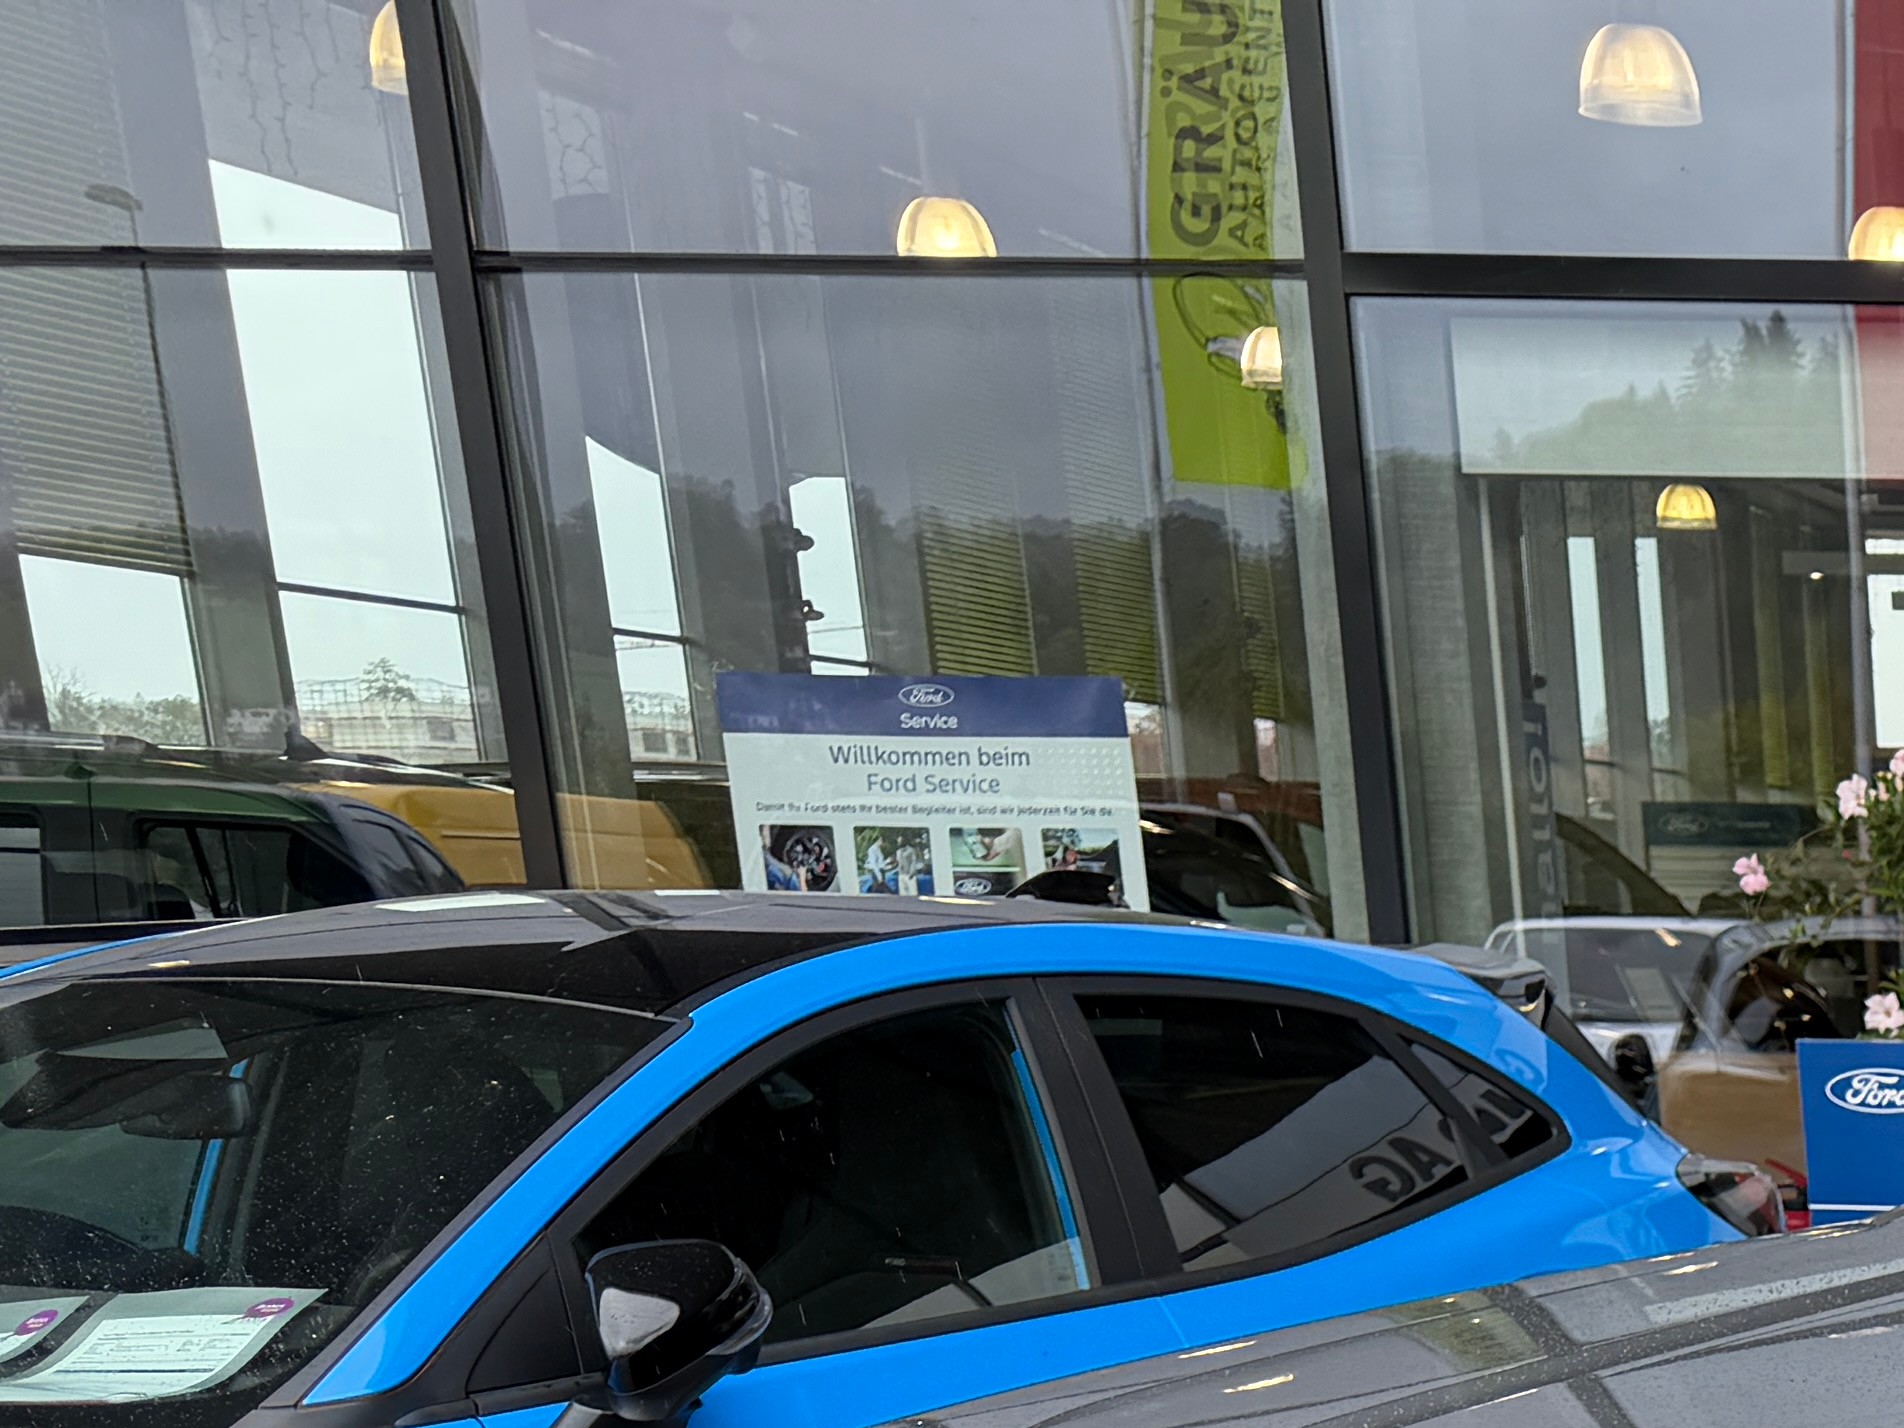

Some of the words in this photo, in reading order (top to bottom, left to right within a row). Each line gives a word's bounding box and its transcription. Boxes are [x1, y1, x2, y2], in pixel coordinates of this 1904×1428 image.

[908, 688, 946, 705] Ford
[900, 713, 958, 730] Service
[829, 745, 971, 767] Willkommen
[978, 747, 1030, 767] beim
[867, 774, 918, 793] Ford
[925, 774, 1000, 794] Service
